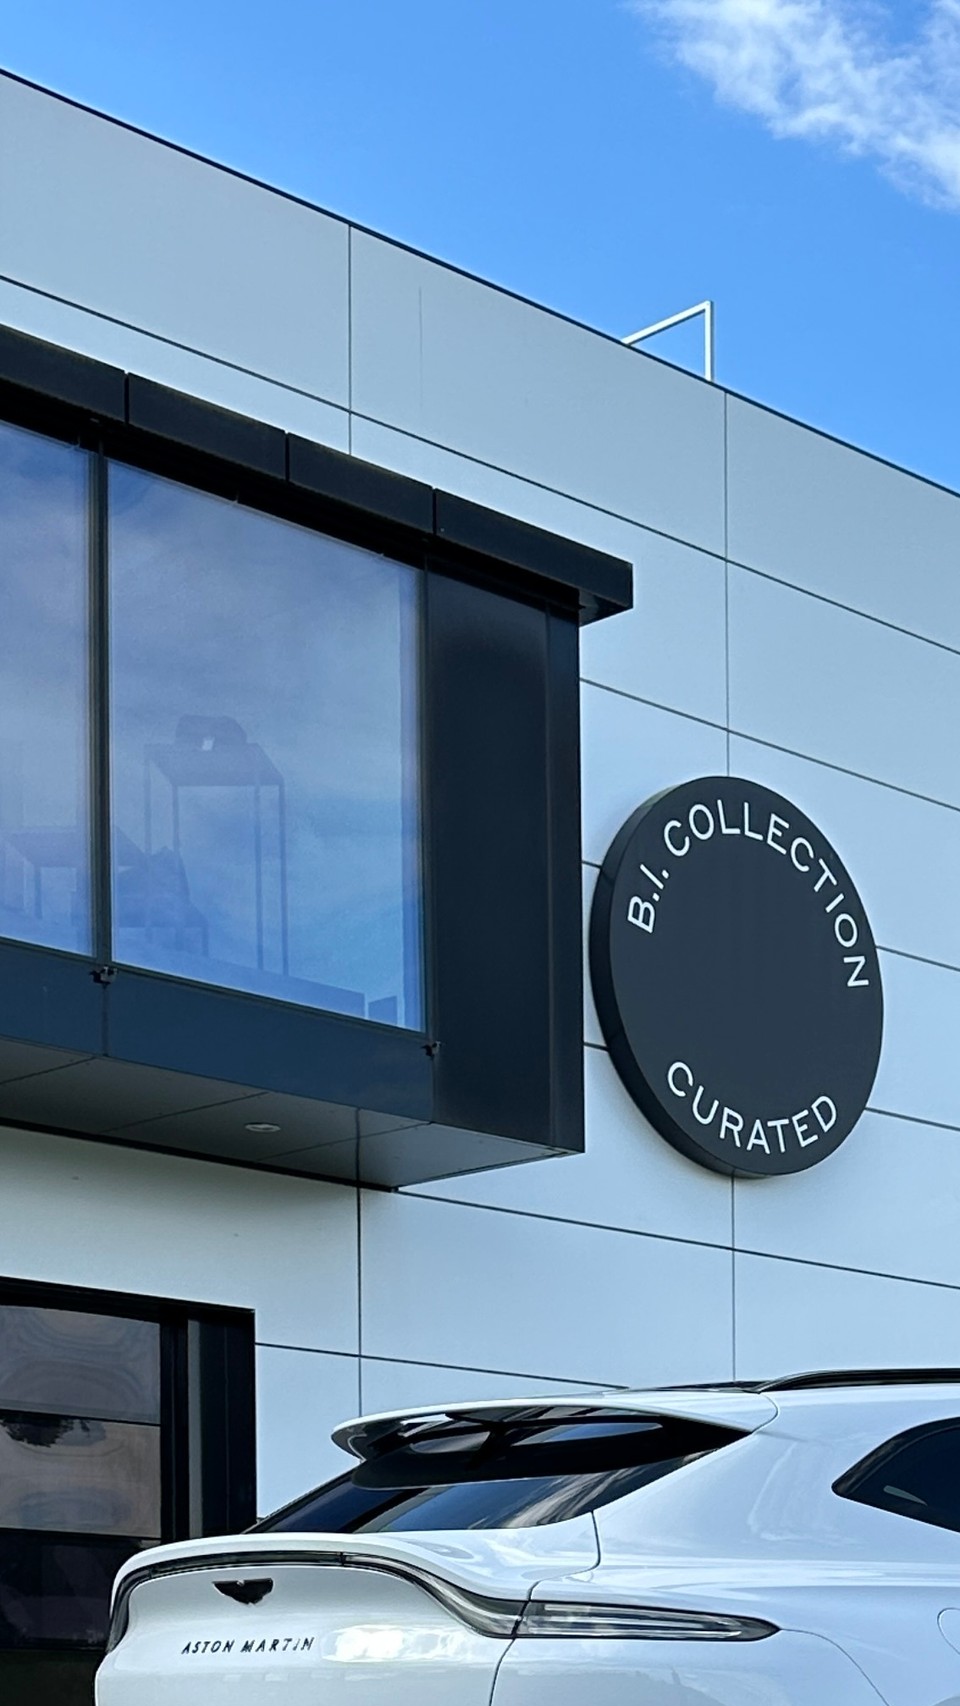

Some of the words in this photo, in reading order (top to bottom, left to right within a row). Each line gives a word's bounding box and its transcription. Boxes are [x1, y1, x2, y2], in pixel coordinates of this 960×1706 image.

[627, 863, 670, 934] B.I.
[663, 799, 870, 988] COLLECTION
[667, 1061, 837, 1154] CURATED
[181, 1639, 235, 1655] ASTON
[240, 1637, 315, 1653] MARTIN
